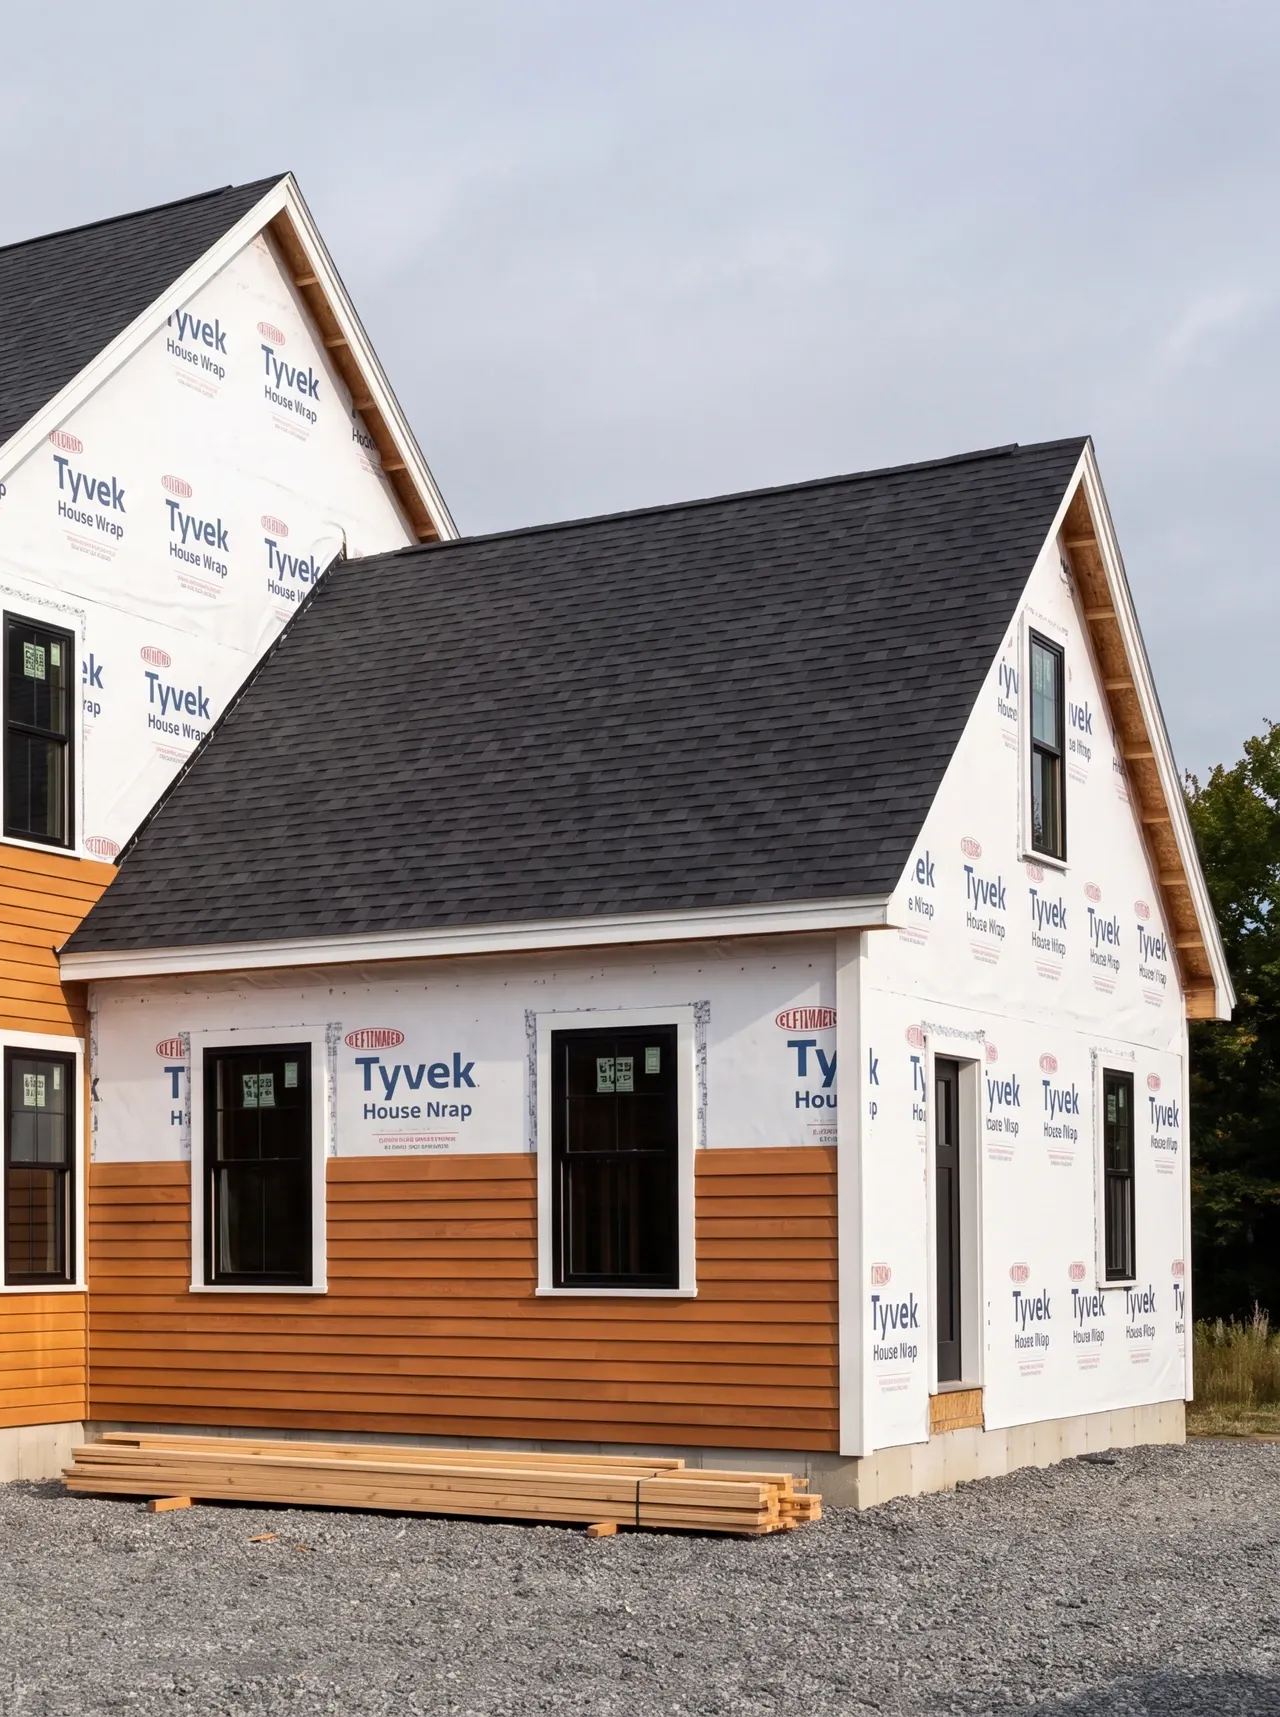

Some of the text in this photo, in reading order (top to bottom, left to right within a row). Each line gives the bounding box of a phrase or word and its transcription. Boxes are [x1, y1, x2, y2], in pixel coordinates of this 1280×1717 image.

[167, 337, 225, 380] House Wrap
[261, 344, 320, 401] Tyvek
[265, 385, 317, 425] House Wrap
[53, 454, 126, 513] Tyvek
[58, 500, 124, 540] House Wrap
[166, 498, 229, 552] Tyvek
[169, 542, 228, 578] House Wrap
[264, 538, 321, 585] Tyvek
[268, 578, 296, 602] House
[83, 699, 101, 718] rap
[145, 671, 211, 720] Tyvek
[148, 713, 179, 736] House
[1069, 701, 1093, 736] vek
[964, 864, 1006, 911] Tyvek
[1029, 888, 1067, 931] Tyvek
[1087, 907, 1120, 947] Tyvek
[1137, 924, 1167, 963] Tyvek
[355, 1052, 475, 1101] Tyvek
[986, 1070, 1021, 1112] yvek
[364, 1103, 421, 1120] House
[795, 1091, 837, 1109] Hou
[1042, 1079, 1079, 1120] Tyvek
[1149, 1096, 1179, 1132] Tyvek
[871, 1292, 918, 1341] Tyvek
[1012, 1288, 1051, 1331] Tyvek
[1071, 1288, 1105, 1326] Tyvek
[1124, 1285, 1156, 1323] Tyvek
